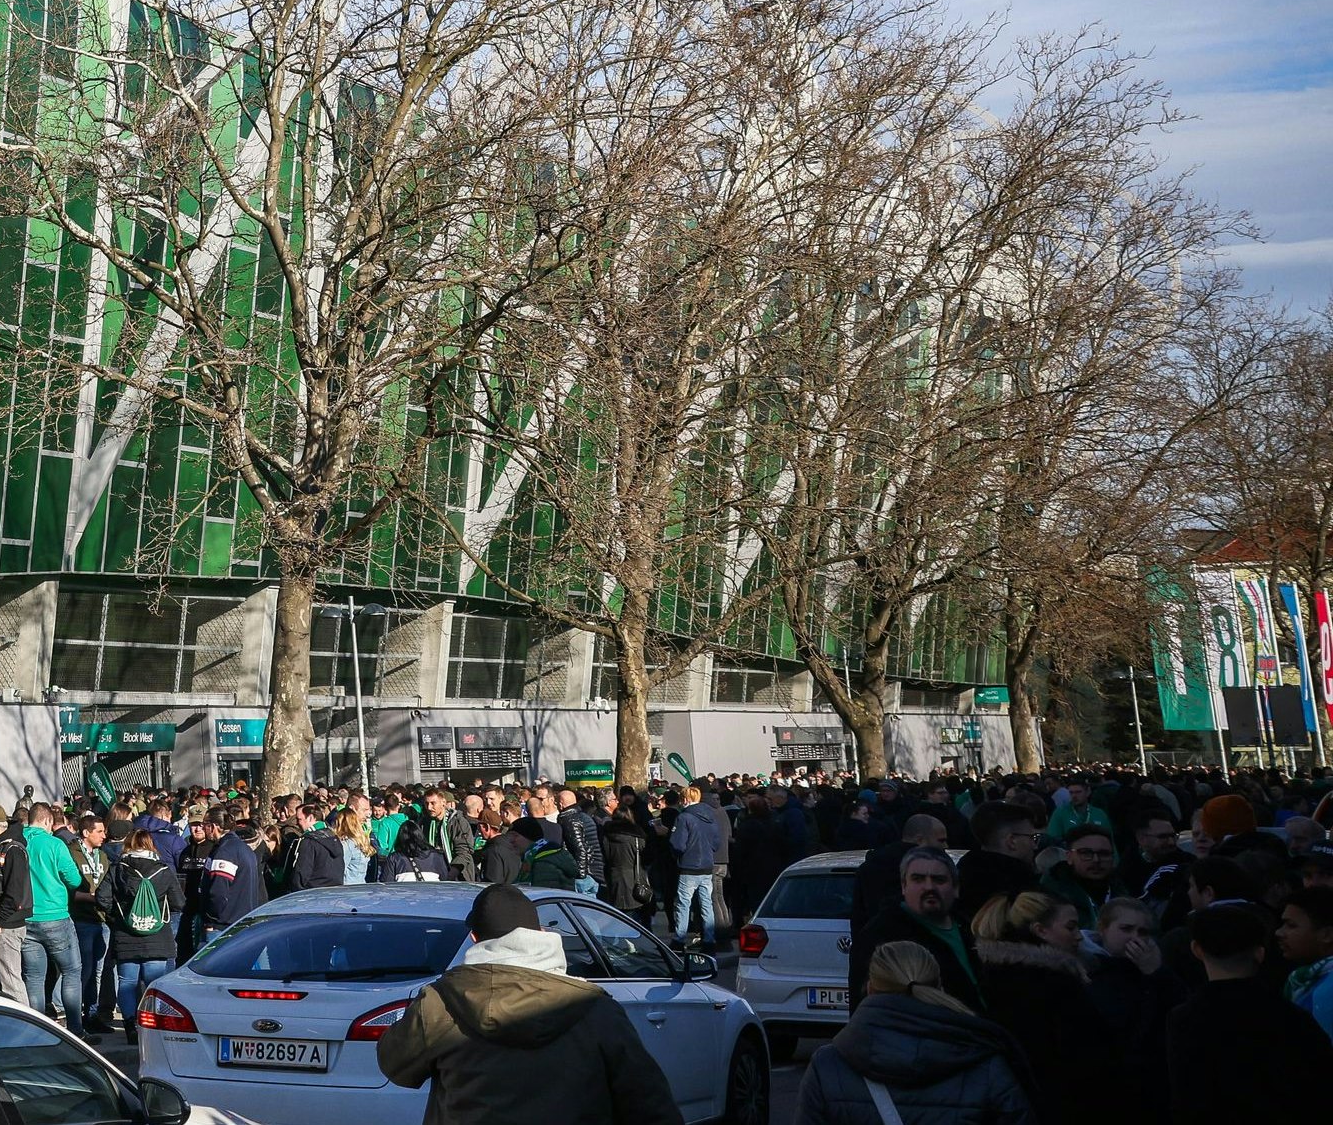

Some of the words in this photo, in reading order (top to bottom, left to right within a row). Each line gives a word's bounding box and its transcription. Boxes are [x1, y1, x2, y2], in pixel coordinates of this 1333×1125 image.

[218, 722, 242, 733] Kassen
[68, 732, 83, 743] West
[123, 731, 139, 743] Block
[139, 732, 154, 743] West
[820, 991, 834, 1003] PL
[232, 1041, 243, 1059] W
[255, 1043, 307, 1062] 82697
[309, 1045, 321, 1063] A
